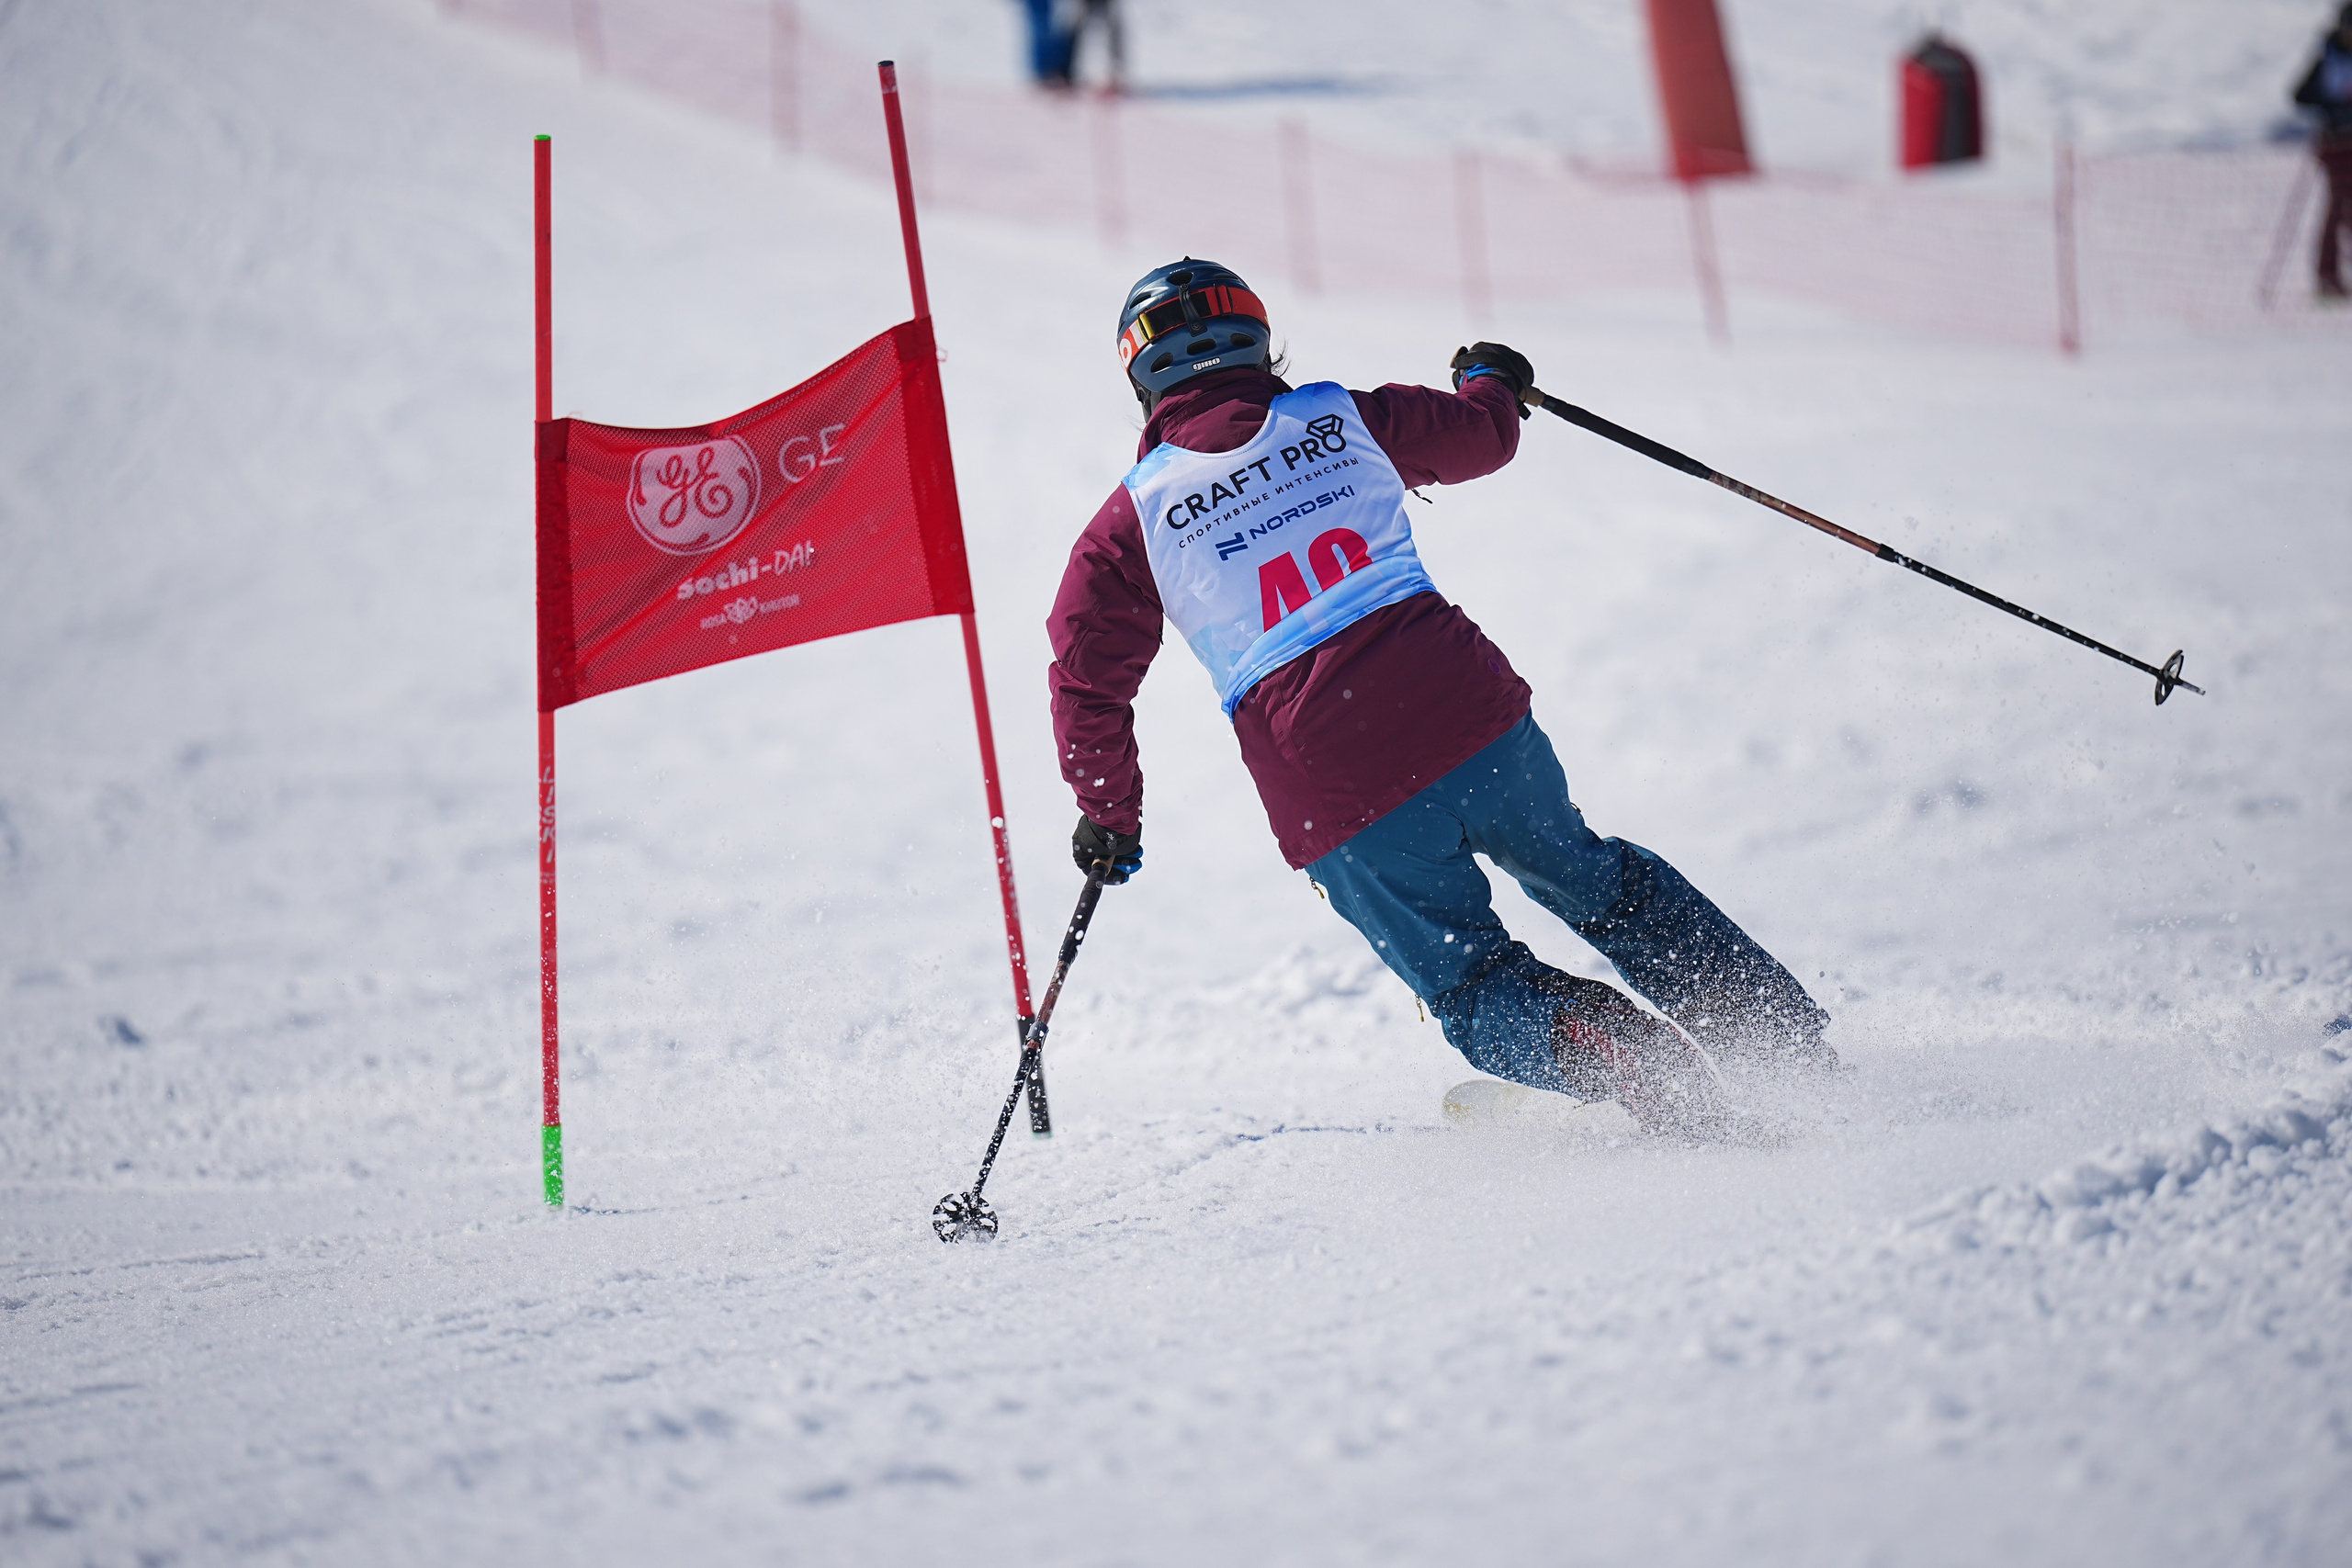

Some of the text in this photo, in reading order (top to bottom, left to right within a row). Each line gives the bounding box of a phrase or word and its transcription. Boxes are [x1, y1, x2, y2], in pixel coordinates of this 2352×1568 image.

[779, 423, 846, 482] GE
[1166, 430, 1347, 530] CRAFT PRO
[1179, 457, 1360, 548] СПОРТИВНЫЕ ИНТЕНСИВЫ
[1250, 485, 1355, 540] NORDSKI
